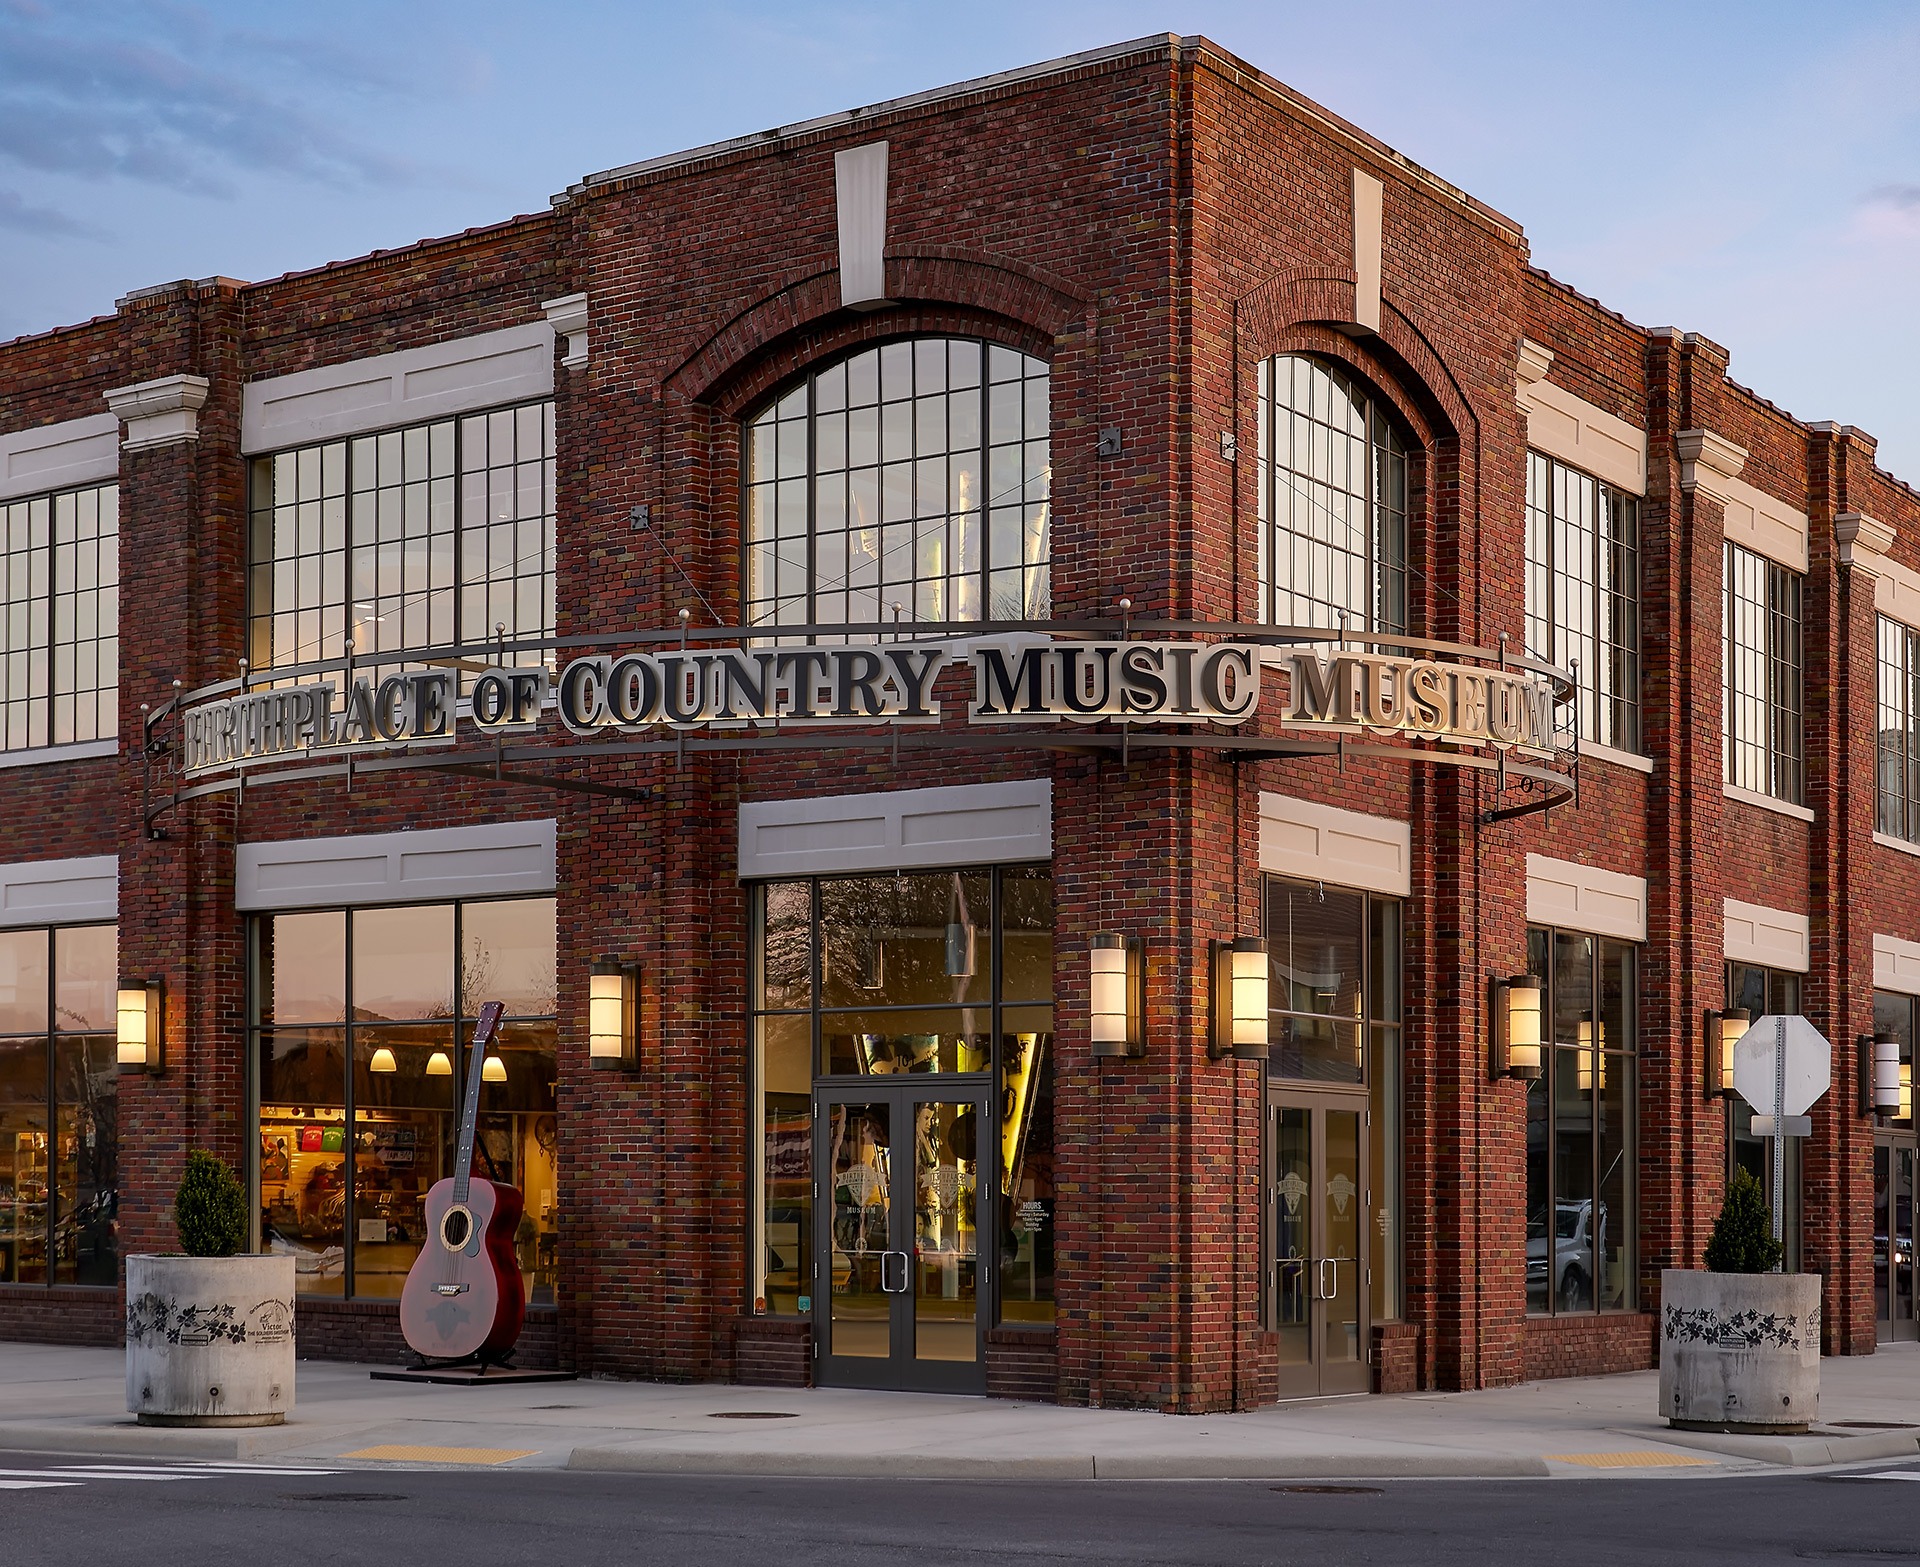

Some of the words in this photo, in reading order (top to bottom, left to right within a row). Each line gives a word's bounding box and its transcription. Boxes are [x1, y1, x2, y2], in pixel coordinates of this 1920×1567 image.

[183, 674, 447, 771] BIRTHPLACE
[473, 674, 539, 725] OF
[561, 649, 942, 728] COUNTRY
[976, 646, 1254, 715] MUSIC
[1292, 655, 1556, 749] MUSEUM
[1022, 1201, 1042, 1210] HOURS
[262, 1322, 282, 1330] Victor
